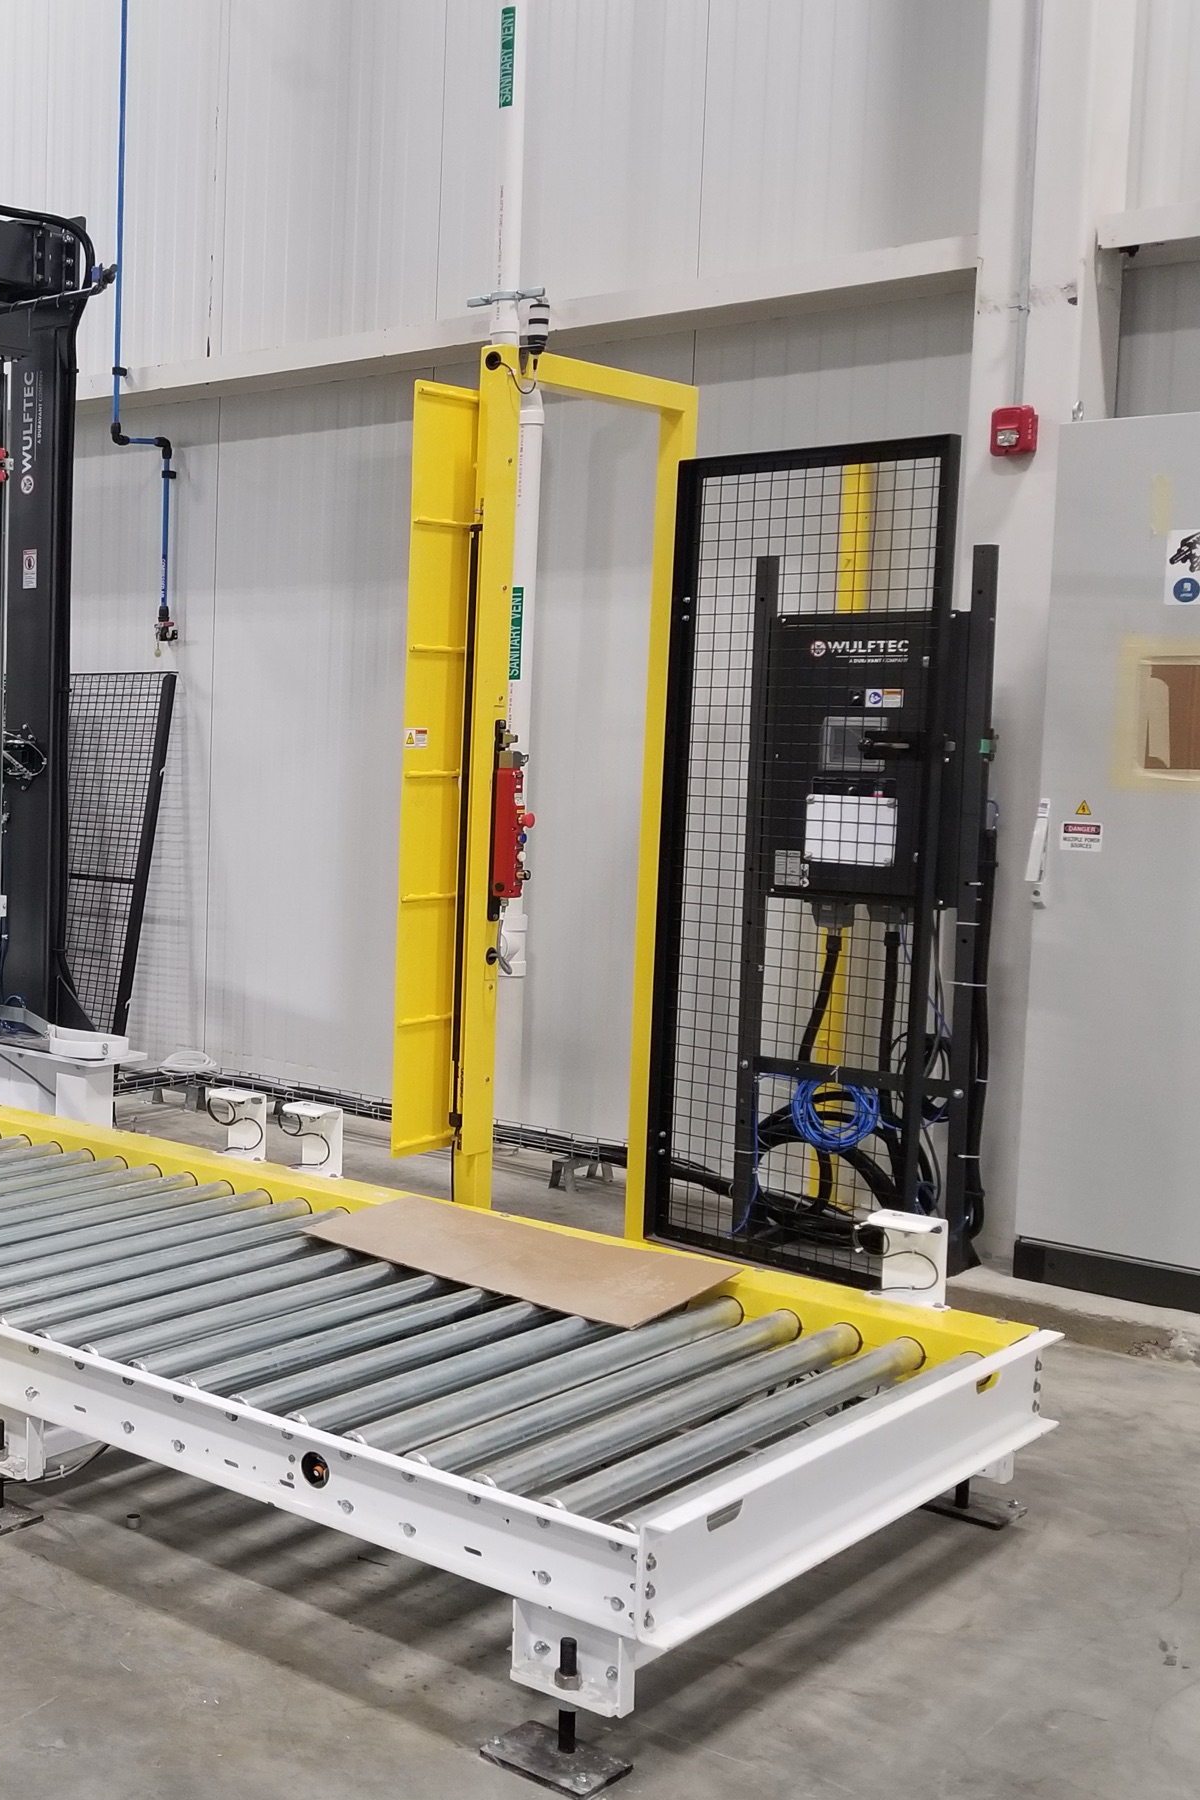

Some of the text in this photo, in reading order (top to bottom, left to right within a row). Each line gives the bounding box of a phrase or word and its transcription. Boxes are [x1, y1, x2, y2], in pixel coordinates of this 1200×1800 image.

[501, 12, 514, 103] SANITARY VENT
[21, 371, 34, 474] WULFTEC
[511, 592, 523, 620] VENT
[509, 625, 521, 676] SANITARY
[827, 639, 909, 653] WULFTEC
[1068, 825, 1096, 833] DANGER
